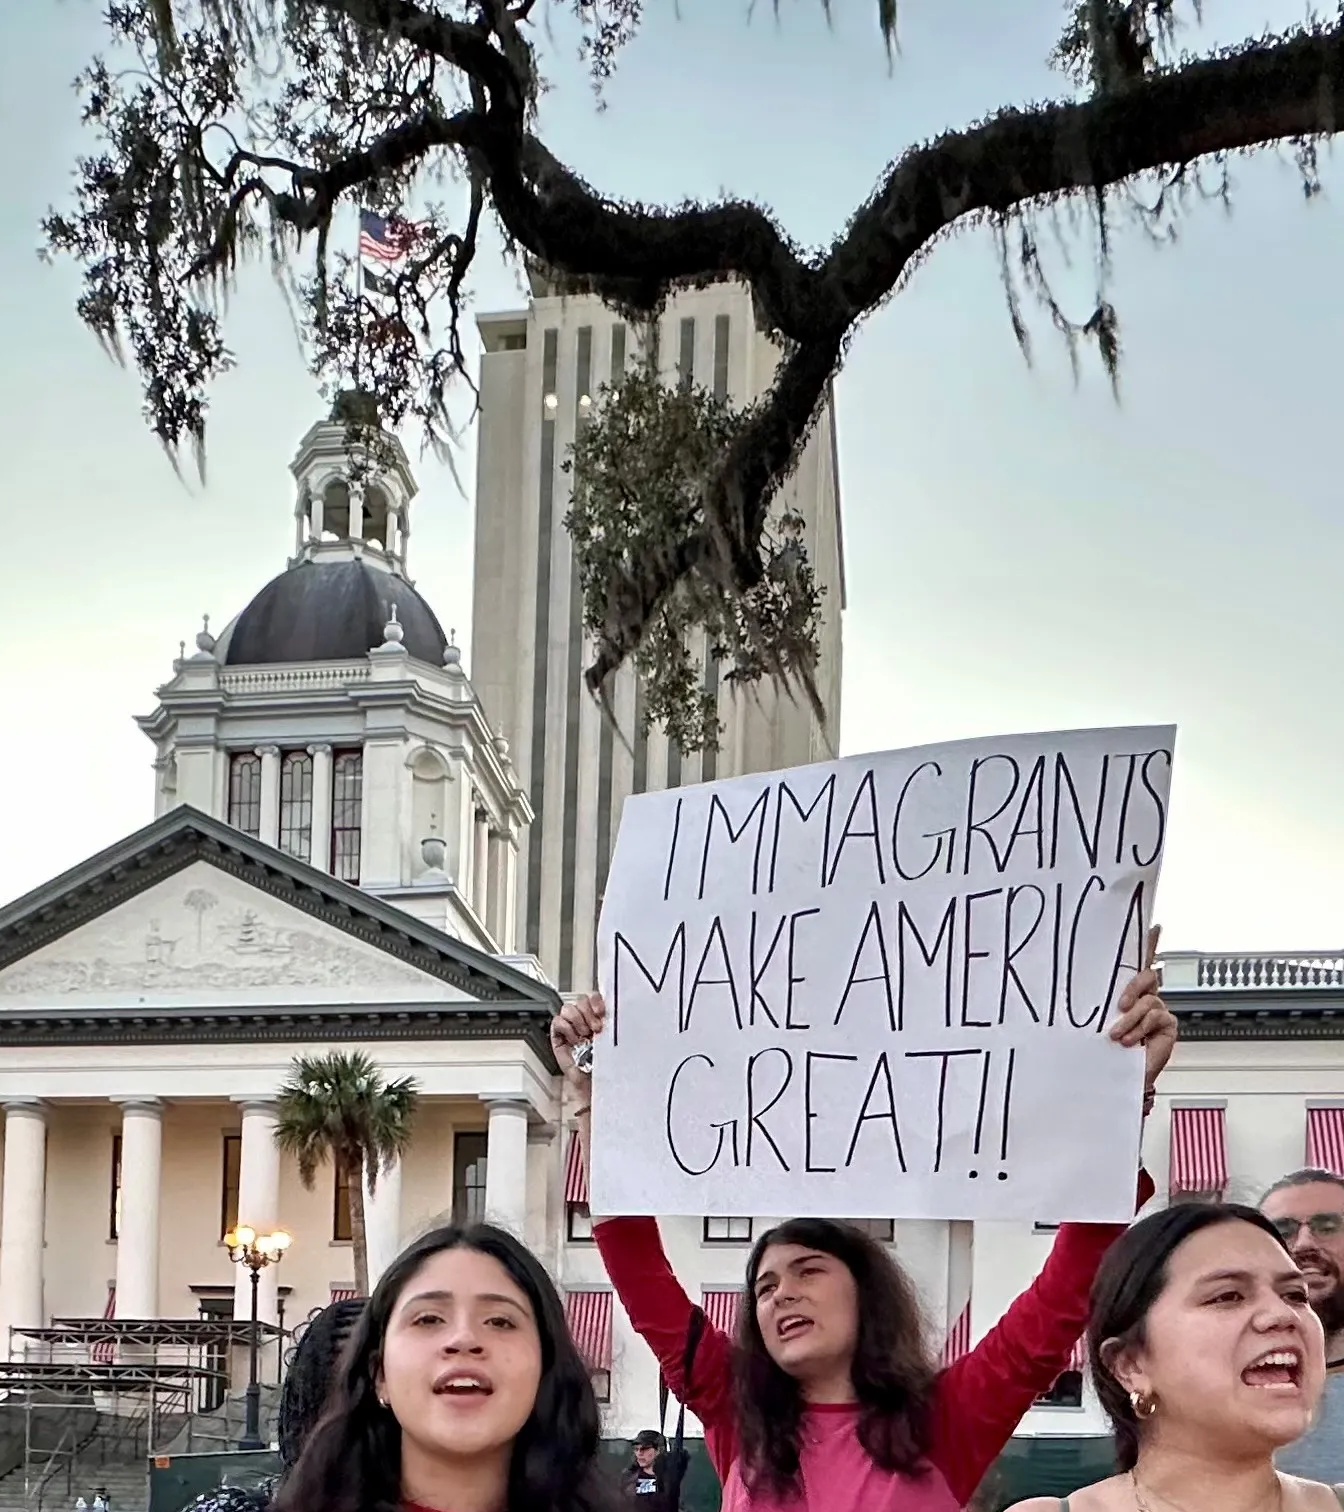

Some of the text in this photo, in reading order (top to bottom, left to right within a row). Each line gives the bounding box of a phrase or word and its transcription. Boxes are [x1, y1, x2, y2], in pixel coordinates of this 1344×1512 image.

[664, 747, 1172, 900] IMMAGRANTS
[613, 875, 1146, 1046] MAKE AMERICA
[666, 1047, 1015, 1181] GREAT!!
